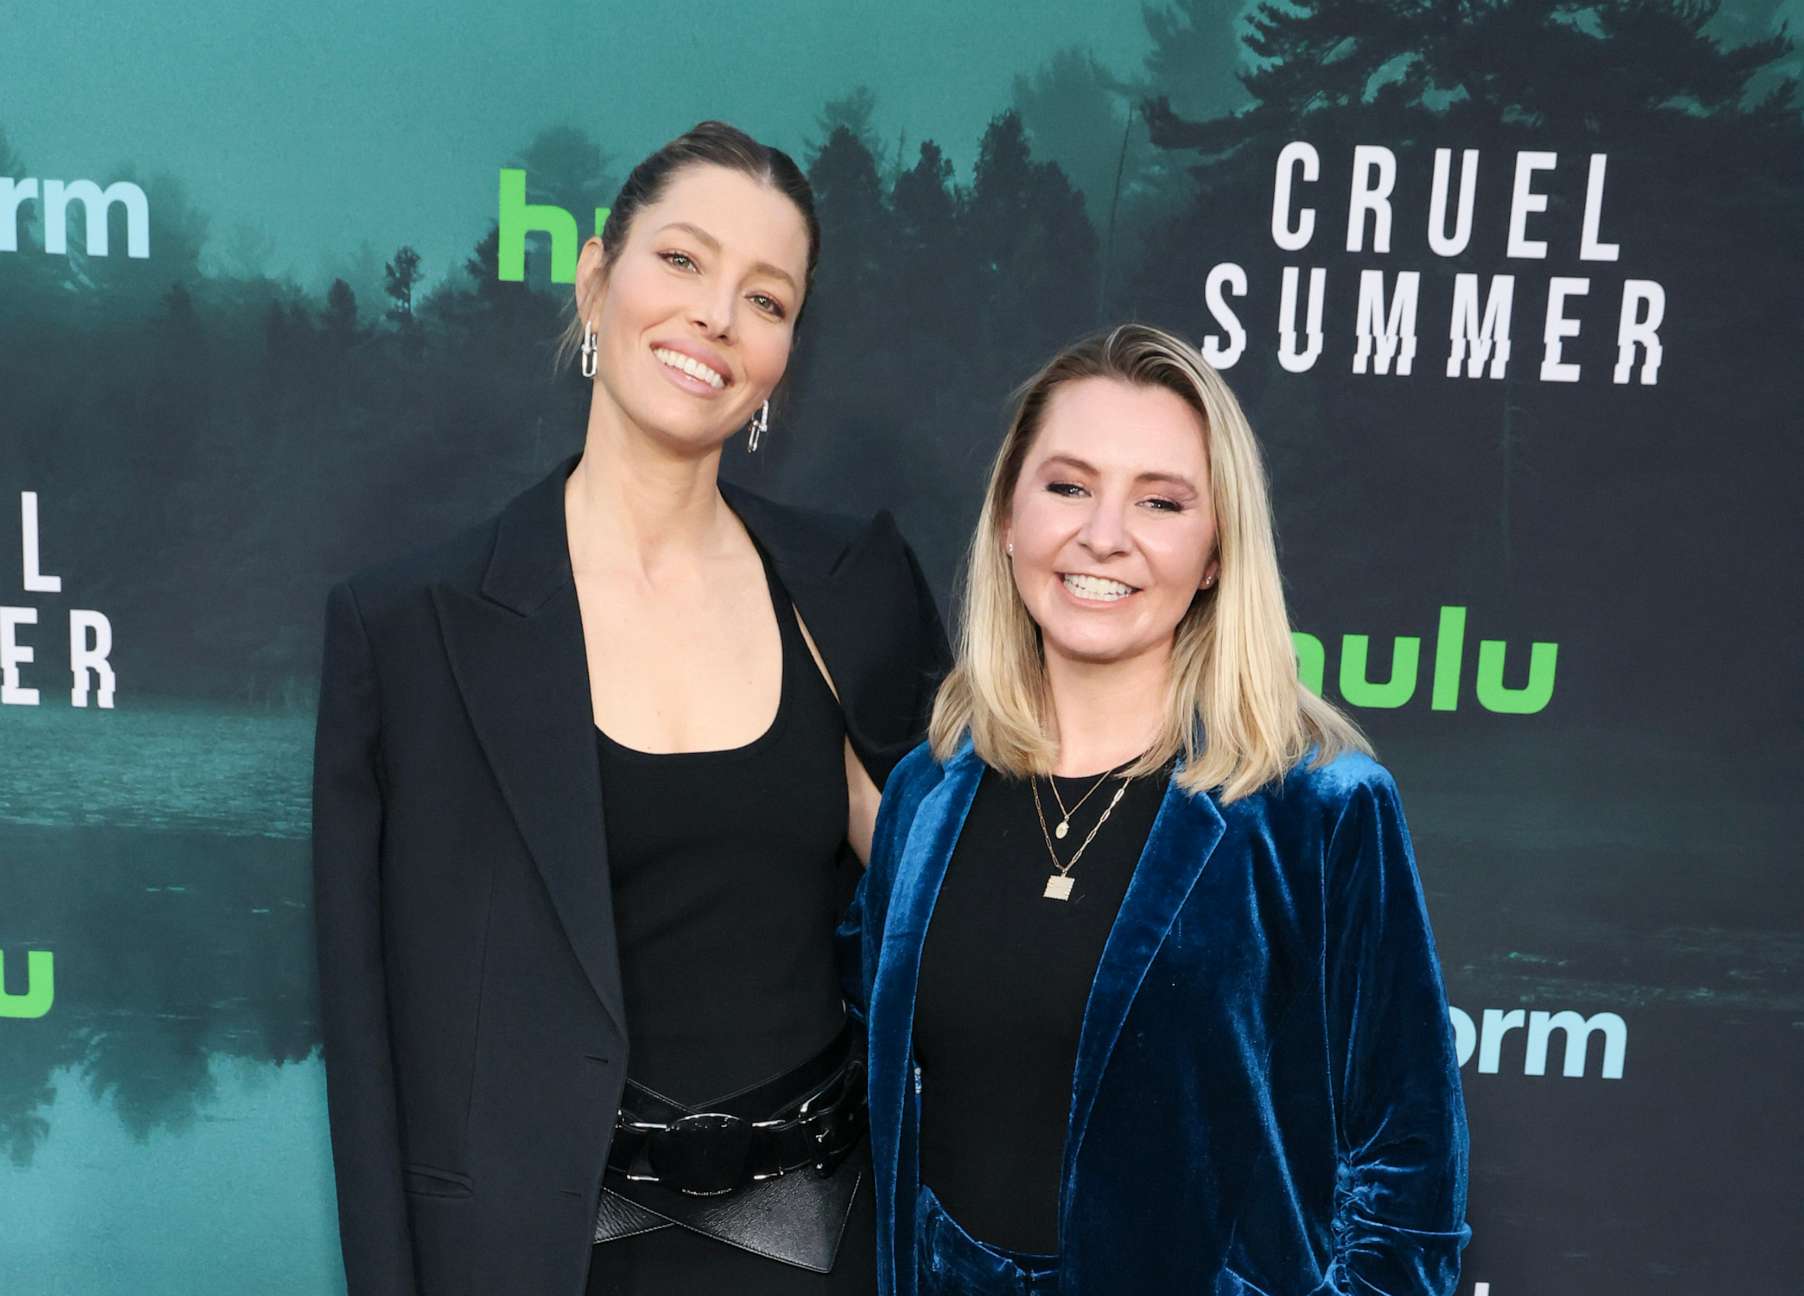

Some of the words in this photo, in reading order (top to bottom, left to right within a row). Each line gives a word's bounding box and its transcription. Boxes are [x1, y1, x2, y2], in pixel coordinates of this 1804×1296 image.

[498, 167, 612, 284] h
[1271, 141, 1620, 262] CRUEL
[1201, 262, 1667, 385] SUMMER
[0, 606, 116, 709] ER
